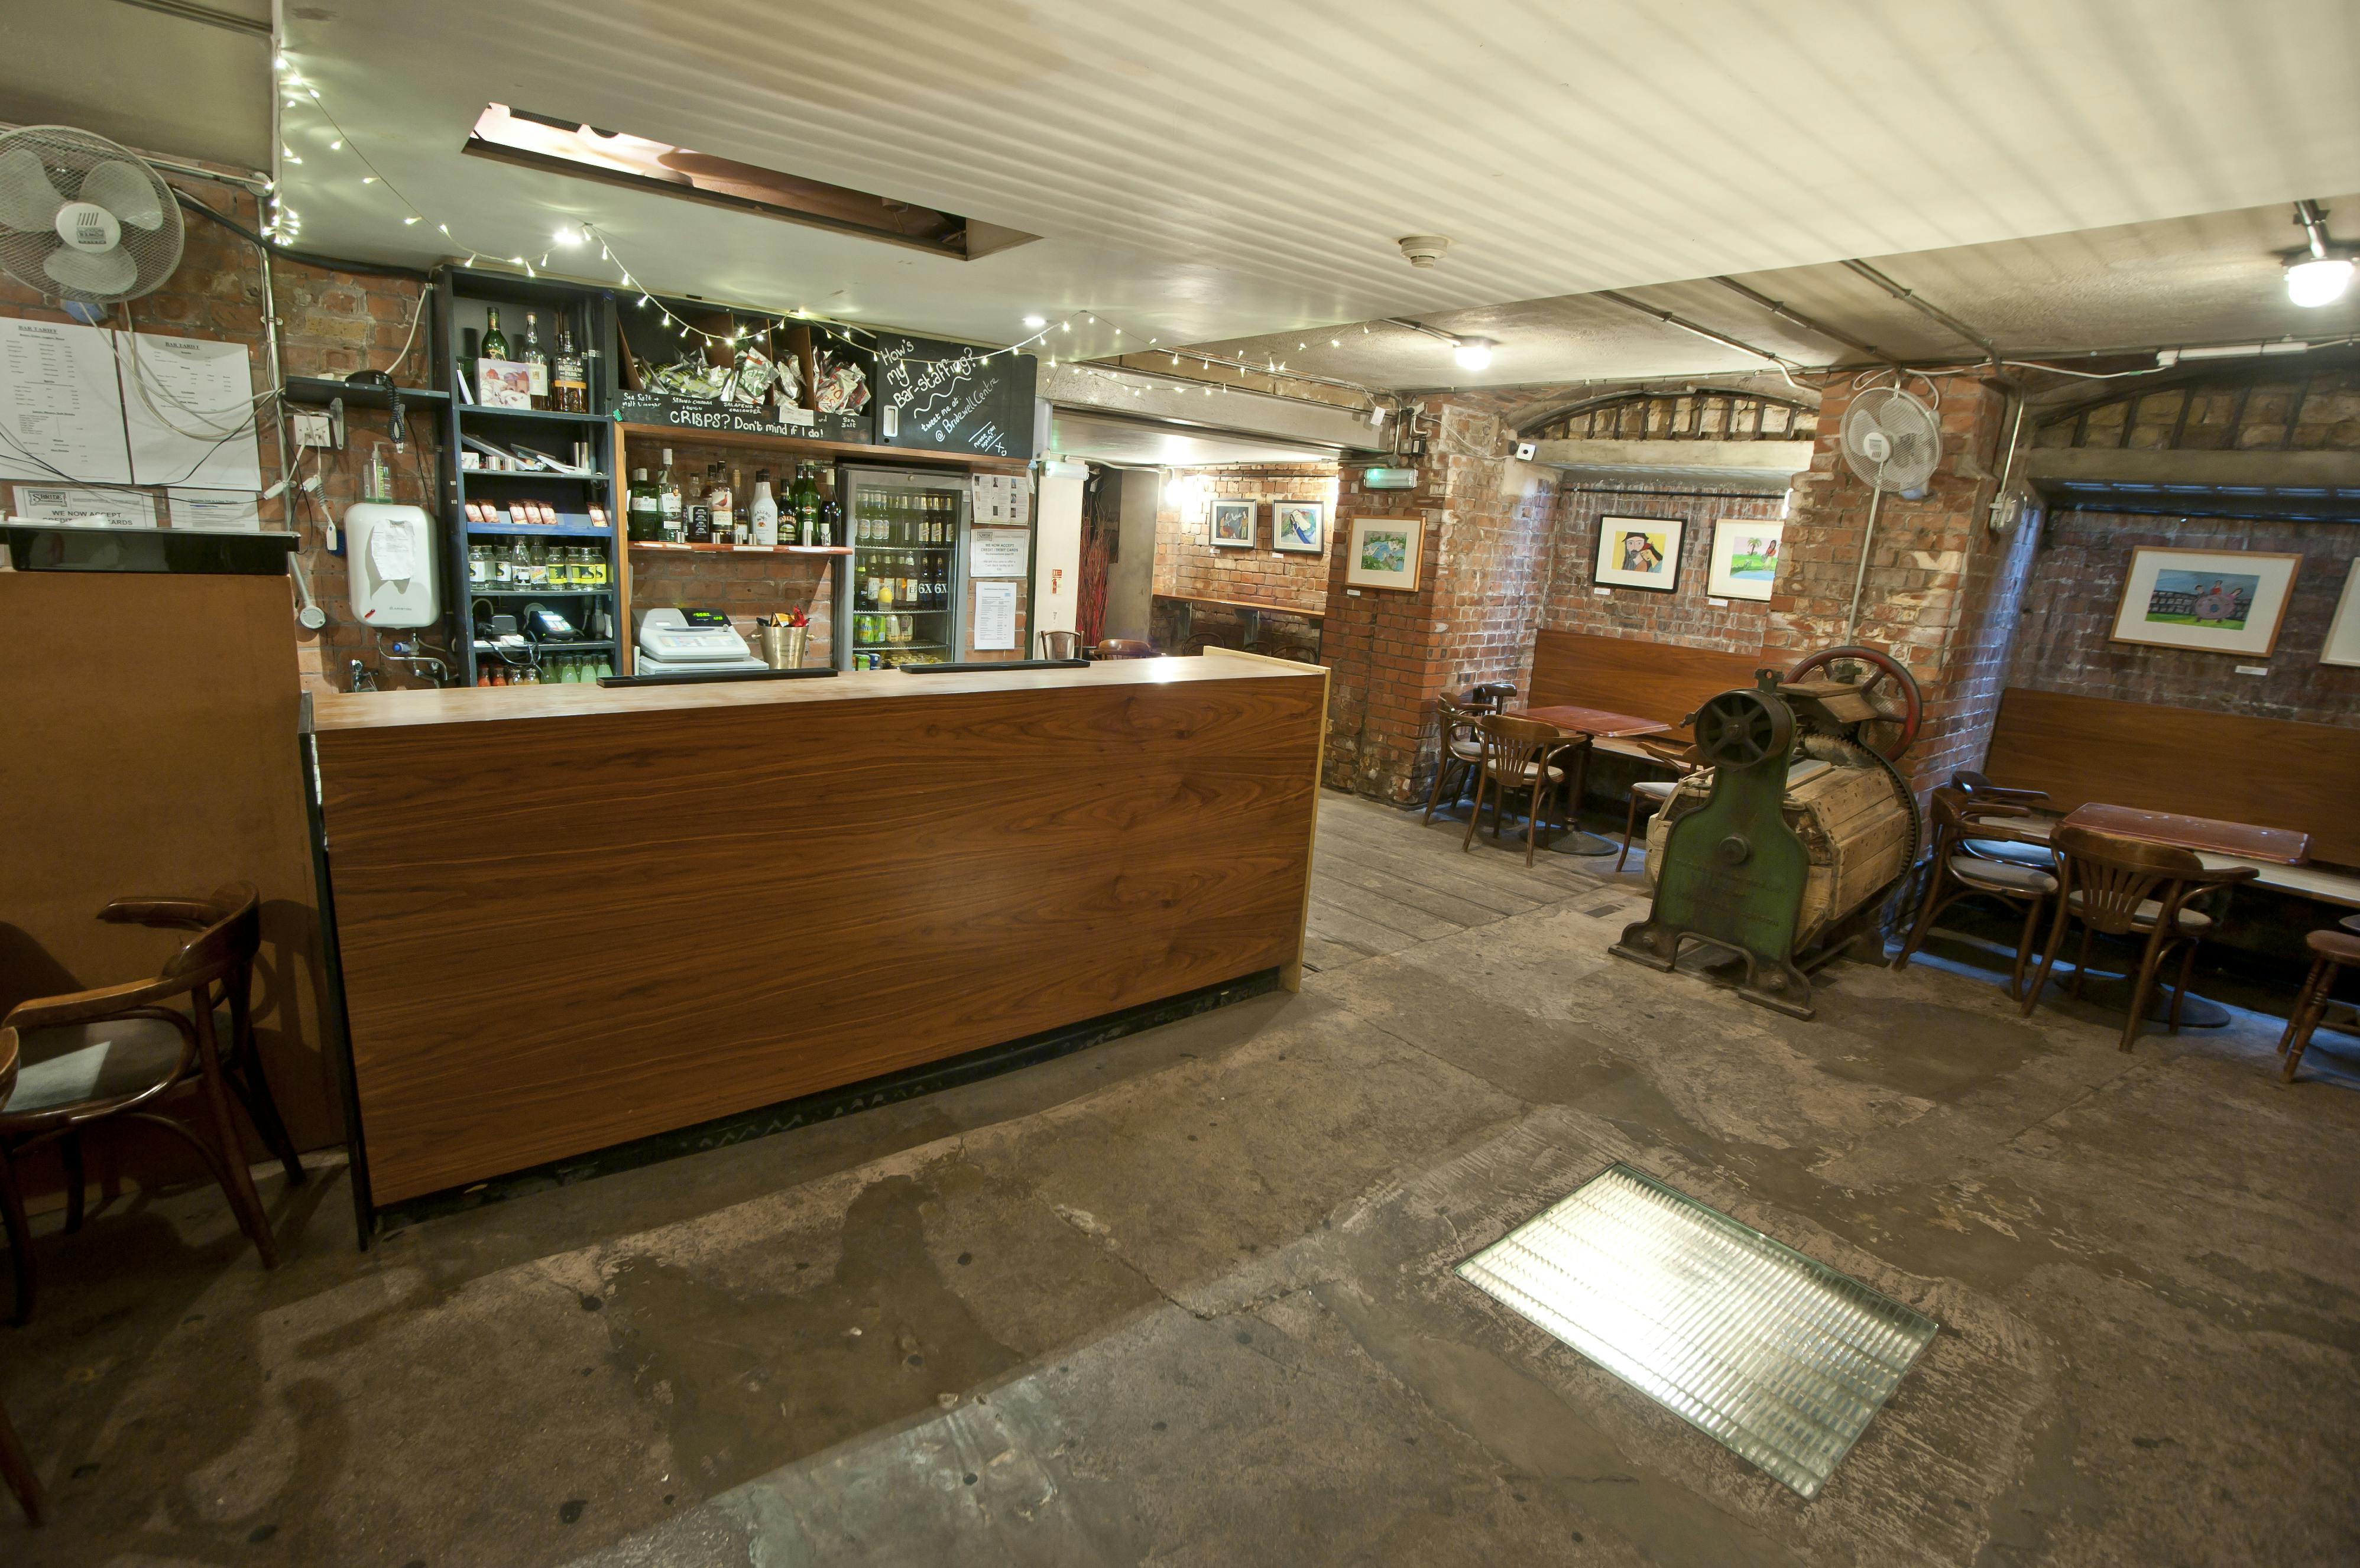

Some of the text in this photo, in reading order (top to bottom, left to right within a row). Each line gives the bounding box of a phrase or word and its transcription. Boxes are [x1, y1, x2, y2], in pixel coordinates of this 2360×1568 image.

[880, 339, 915, 366] How's
[887, 365, 910, 387] my
[893, 346, 977, 409] Bar-staffing?
[624, 392, 635, 401] Sea
[637, 393, 652, 401] Salt
[670, 411, 824, 437] CRISPS? Don't mind if I do!
[920, 414, 941, 432] tweet
[942, 404, 952, 416] me
[935, 430, 946, 442] @
[918, 583, 932, 594] 6X
[934, 583, 948, 594] 6X
